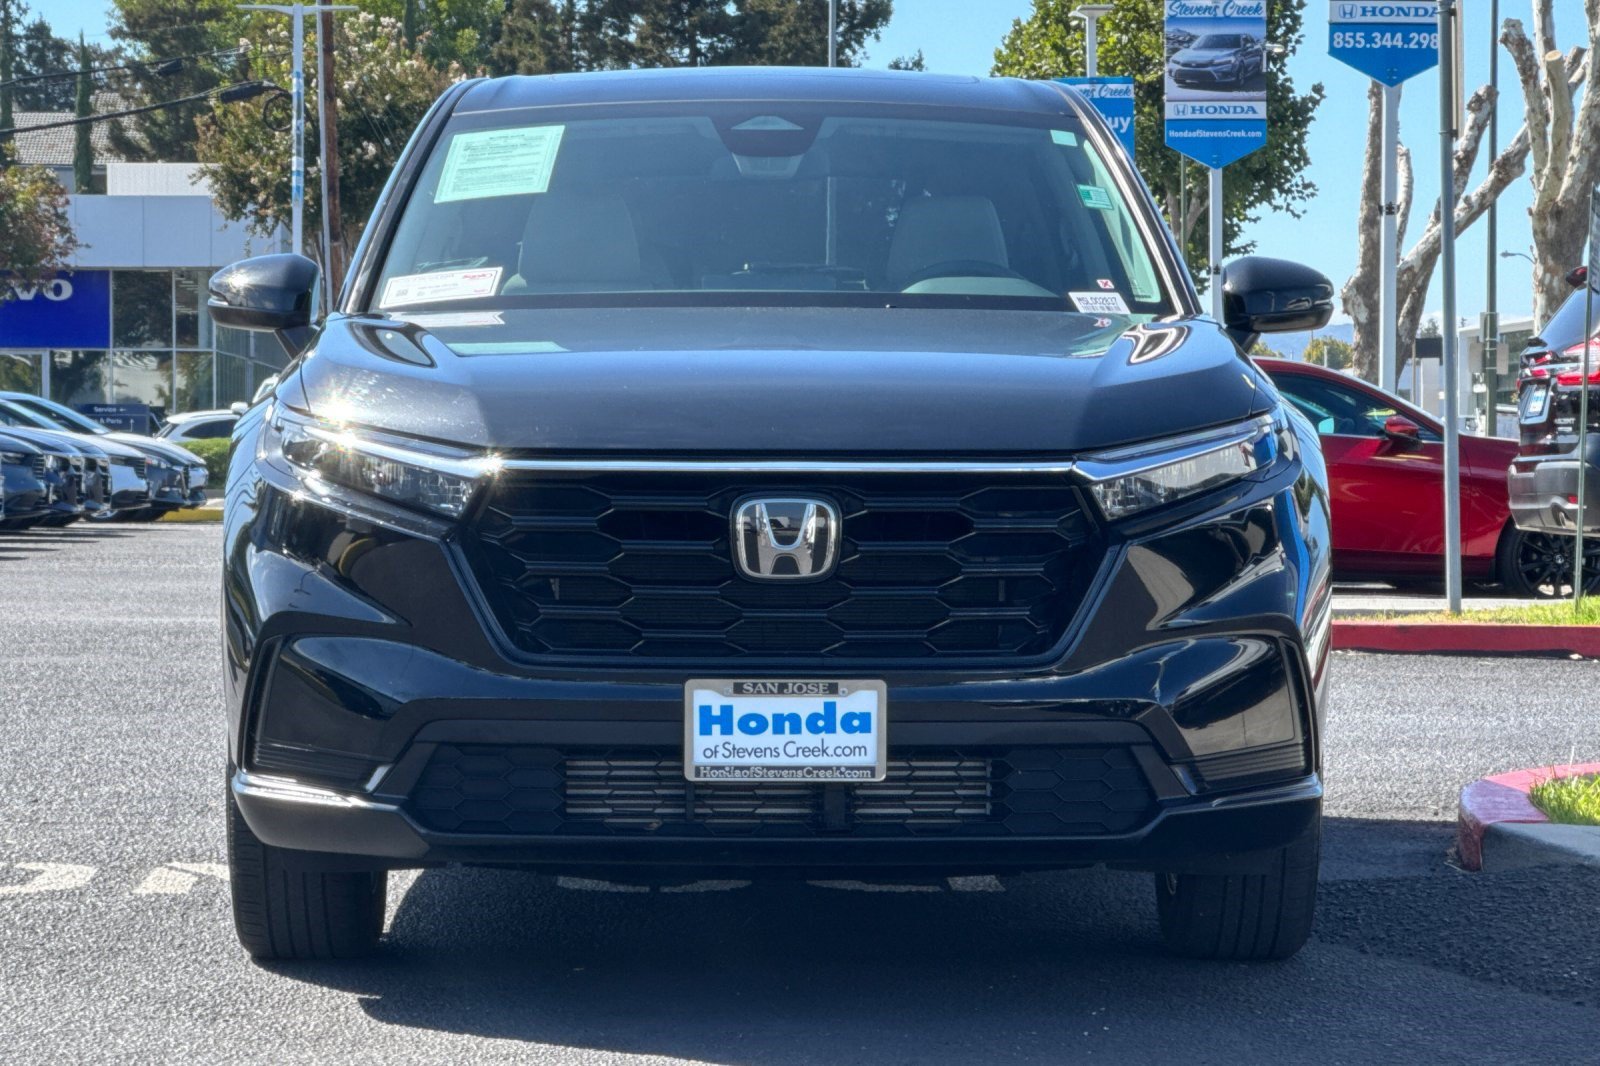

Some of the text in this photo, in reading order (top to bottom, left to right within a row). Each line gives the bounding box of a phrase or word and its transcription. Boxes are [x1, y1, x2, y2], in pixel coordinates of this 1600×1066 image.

[1168, 0, 1263, 17] Stevens Creek
[1333, 32, 1439, 48] 855.344.298
[1099, 84, 1131, 98] Creek
[1190, 105, 1258, 115] HONDA
[1102, 114, 1131, 133] uy
[1169, 129, 1262, 138] HondaofStevensCreek.com
[742, 683, 830, 694] SAN JOSE
[699, 701, 872, 736] Honda
[702, 738, 868, 760] of Stevens Creek.com
[699, 766, 872, 779] HondaofStevensCreek.com
